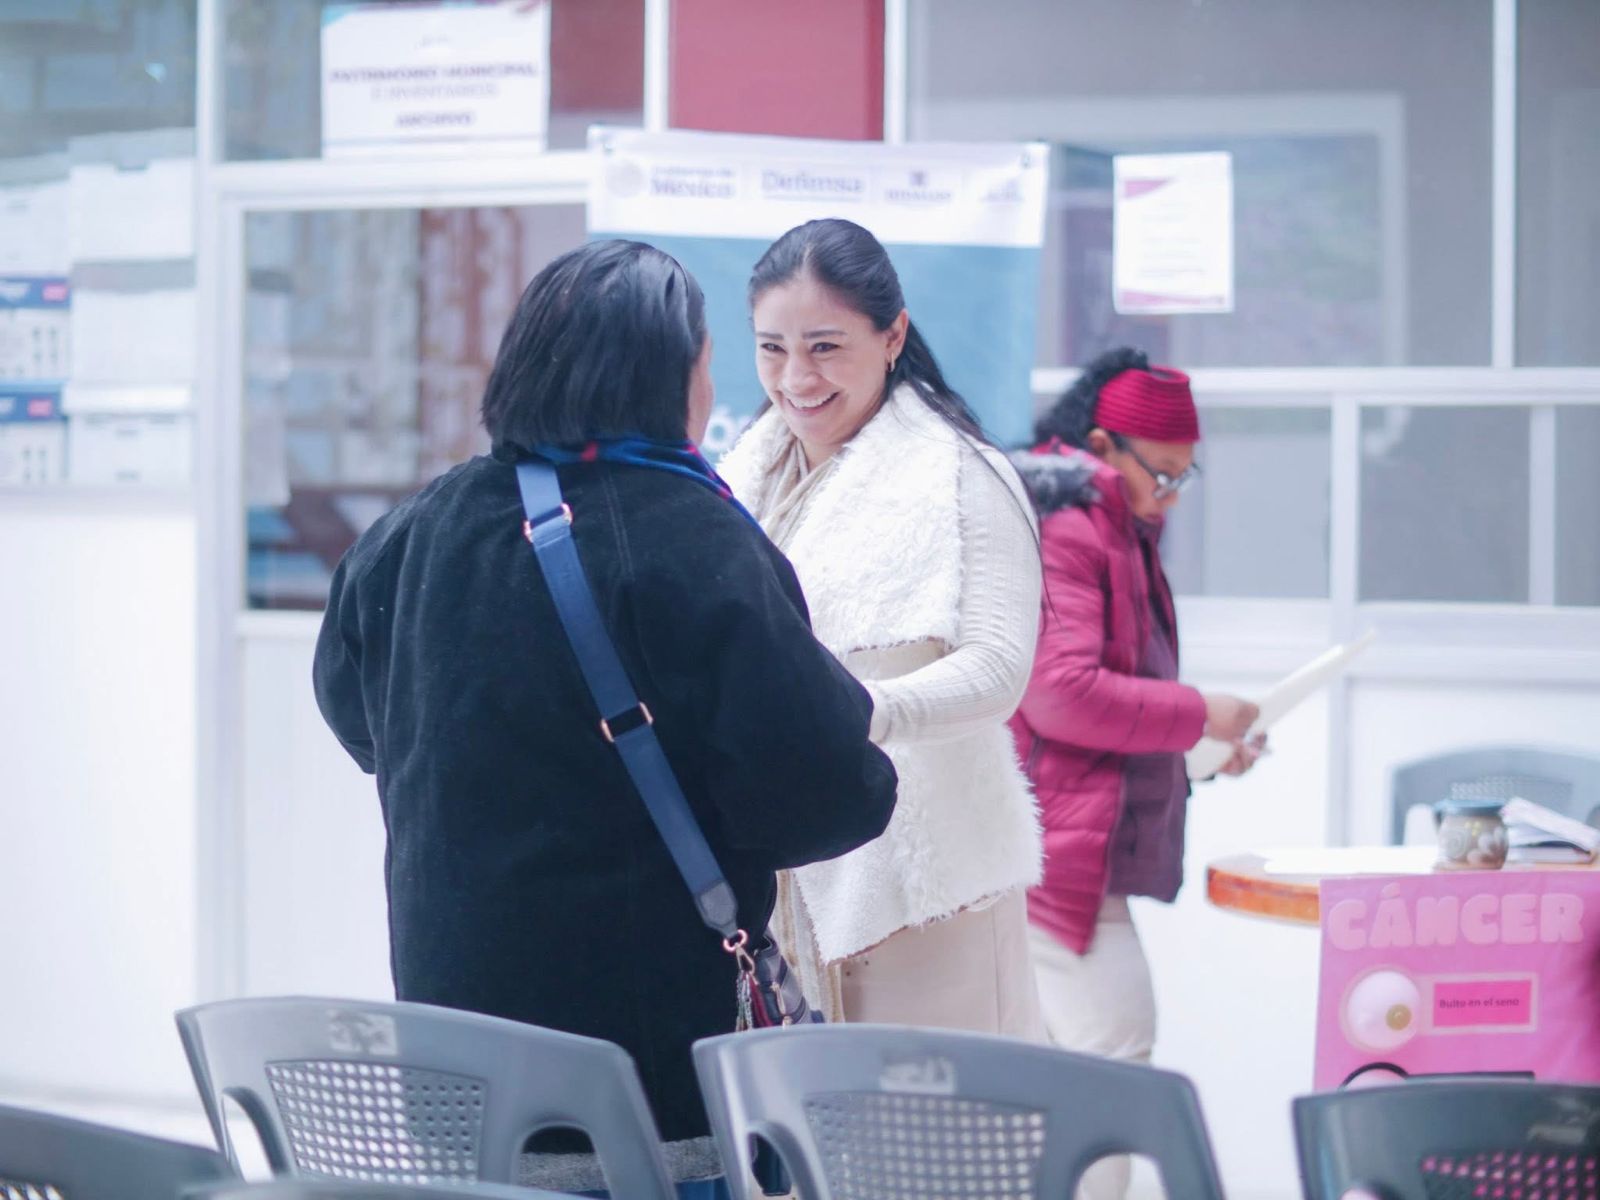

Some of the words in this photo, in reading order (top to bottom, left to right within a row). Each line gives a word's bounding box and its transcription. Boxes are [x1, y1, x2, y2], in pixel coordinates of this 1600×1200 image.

[330, 68, 437, 83] PATRIMONIO
[442, 63, 535, 79] MUNICIPAL
[761, 168, 861, 193] Defensa
[1328, 883, 1584, 950] CÁNCER
[1439, 998, 1466, 1009] Bulto
[1467, 998, 1482, 1008] en
[1494, 996, 1520, 1007] seno
